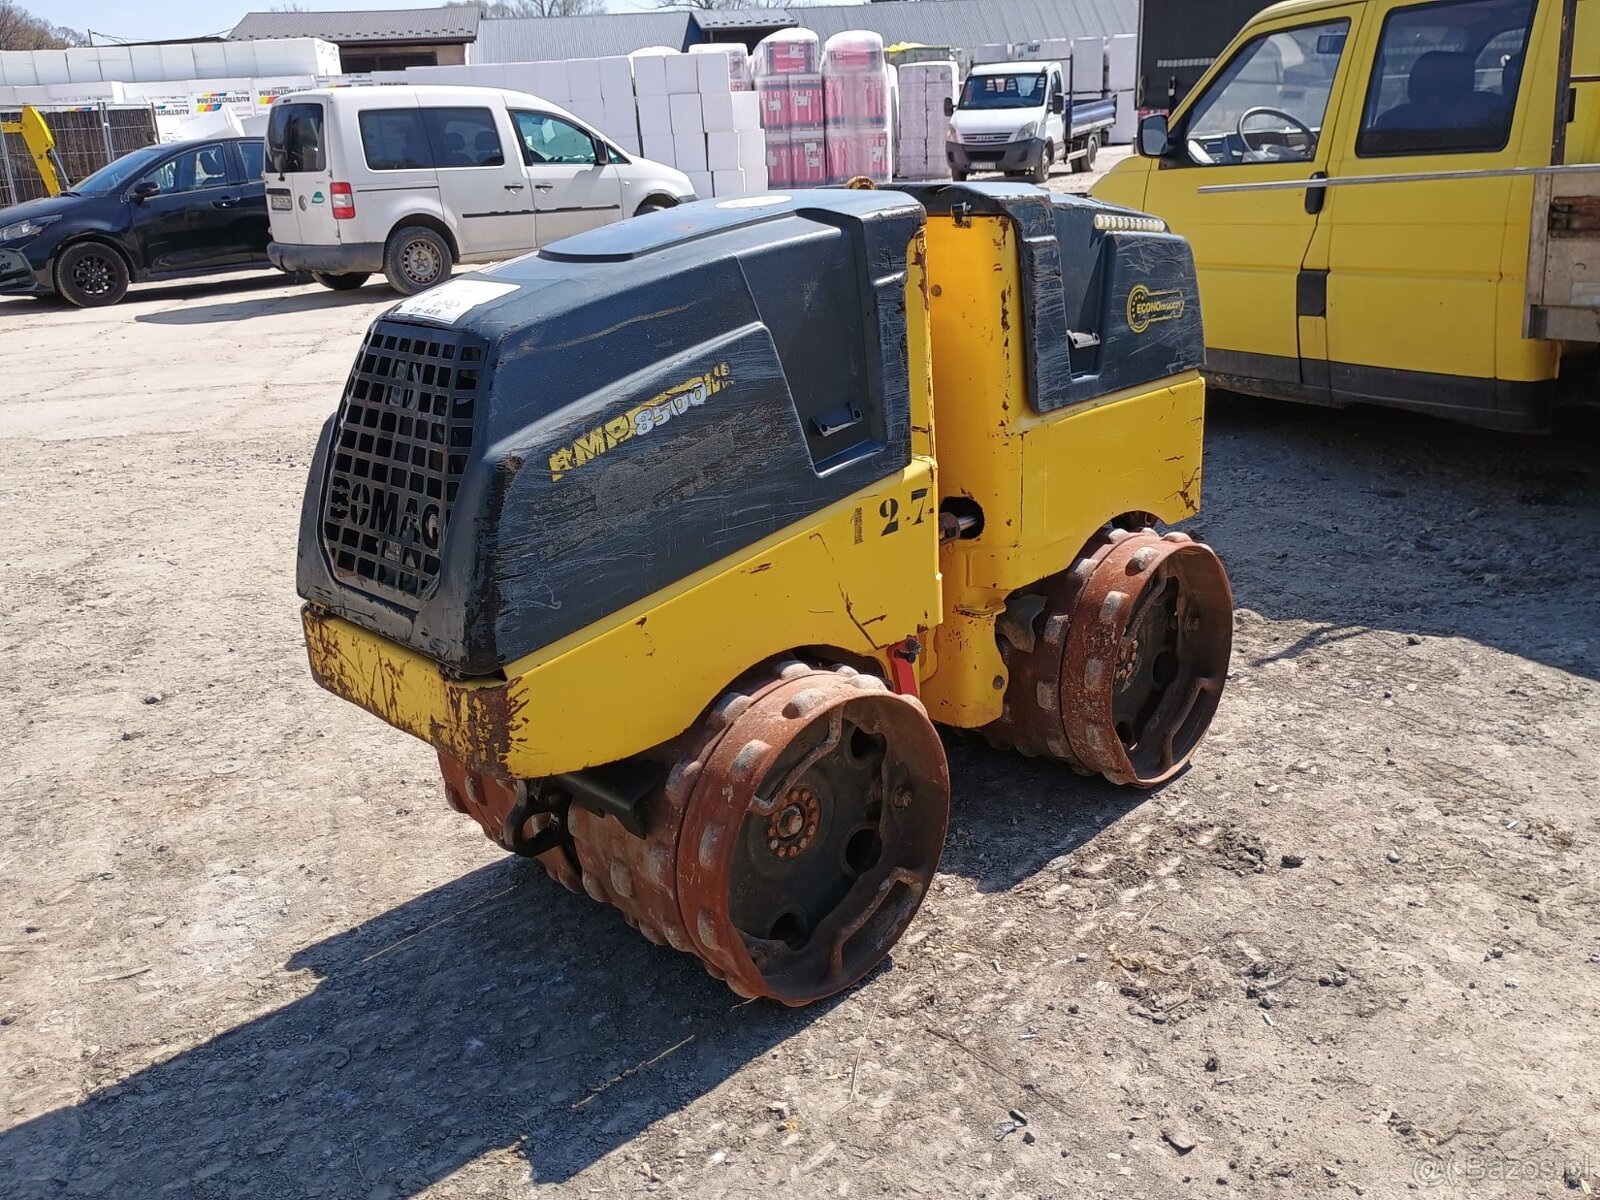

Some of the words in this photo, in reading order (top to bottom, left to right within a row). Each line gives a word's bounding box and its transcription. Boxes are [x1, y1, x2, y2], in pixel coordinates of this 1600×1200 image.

[196, 96, 250, 104] AUSTROTHERM
[633, 382, 707, 436] 8500
[329, 475, 440, 550] BOMAG
